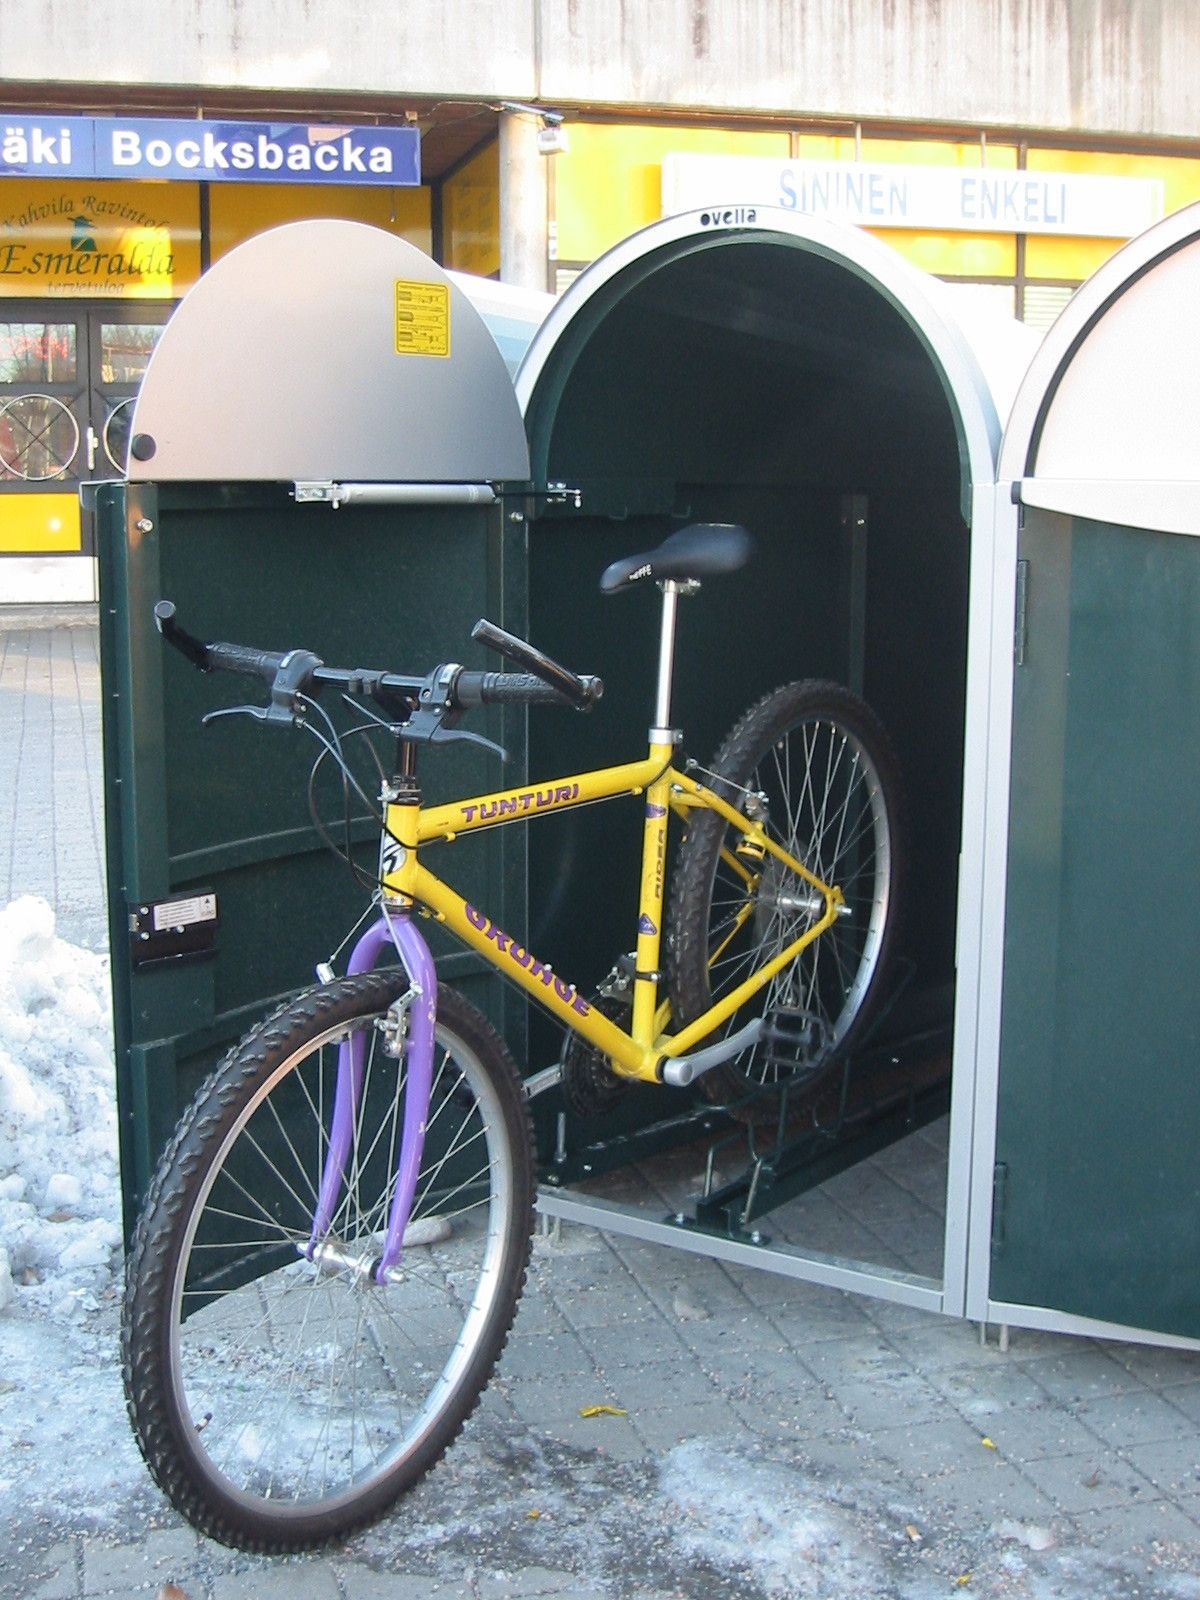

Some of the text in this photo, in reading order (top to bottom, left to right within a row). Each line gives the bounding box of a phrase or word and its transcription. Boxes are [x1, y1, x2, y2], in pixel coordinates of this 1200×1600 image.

[2, 127, 393, 173] äki Bocksbacka
[779, 168, 1066, 224] SININEN ENKELI
[0, 241, 176, 275] Esmeralda
[461, 784, 580, 823] TUNTURI
[465, 901, 590, 1018] GRUNGE
